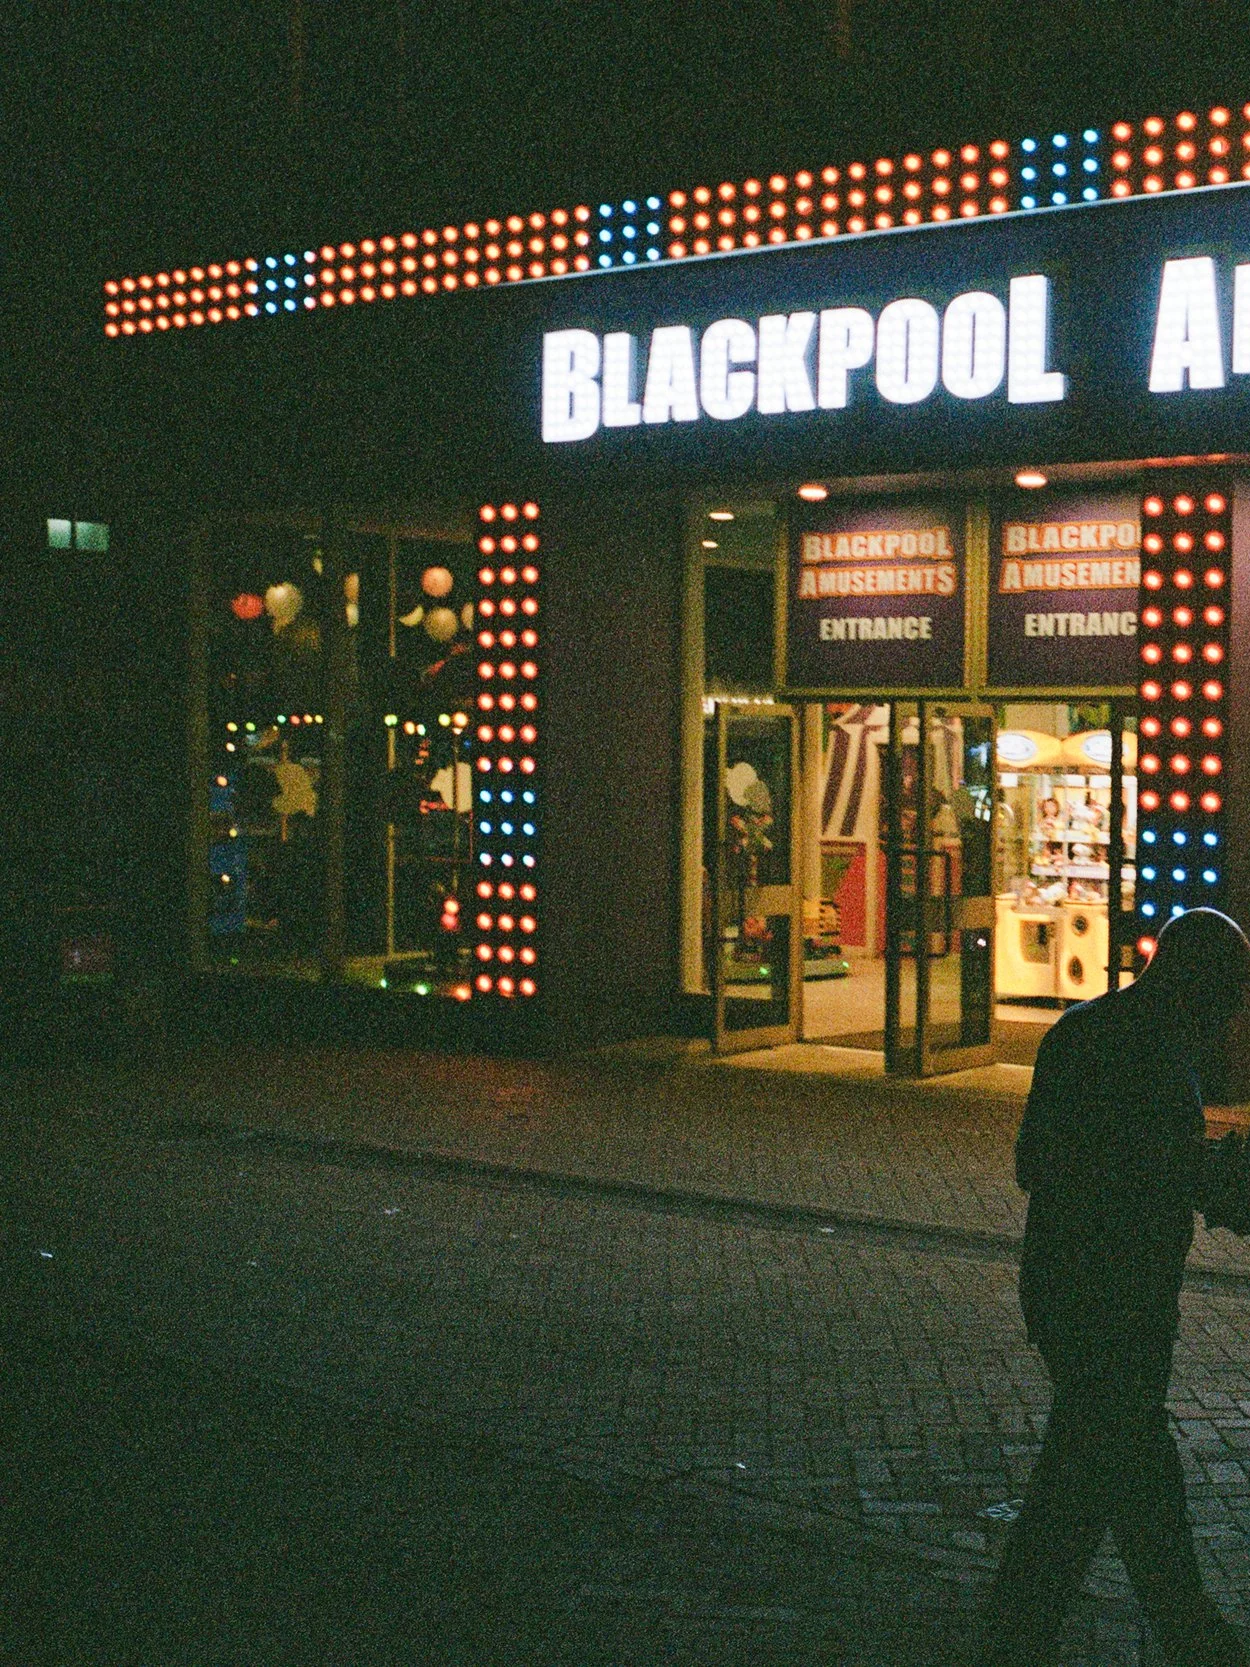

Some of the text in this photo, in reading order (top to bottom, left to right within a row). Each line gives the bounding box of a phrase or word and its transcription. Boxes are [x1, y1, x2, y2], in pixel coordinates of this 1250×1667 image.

[542, 274, 1067, 443] BLACKPOOL
[804, 528, 952, 561] BLACKPOOL
[801, 565, 955, 597] AMUSEMENTS
[819, 616, 932, 641] ENTRANCE
